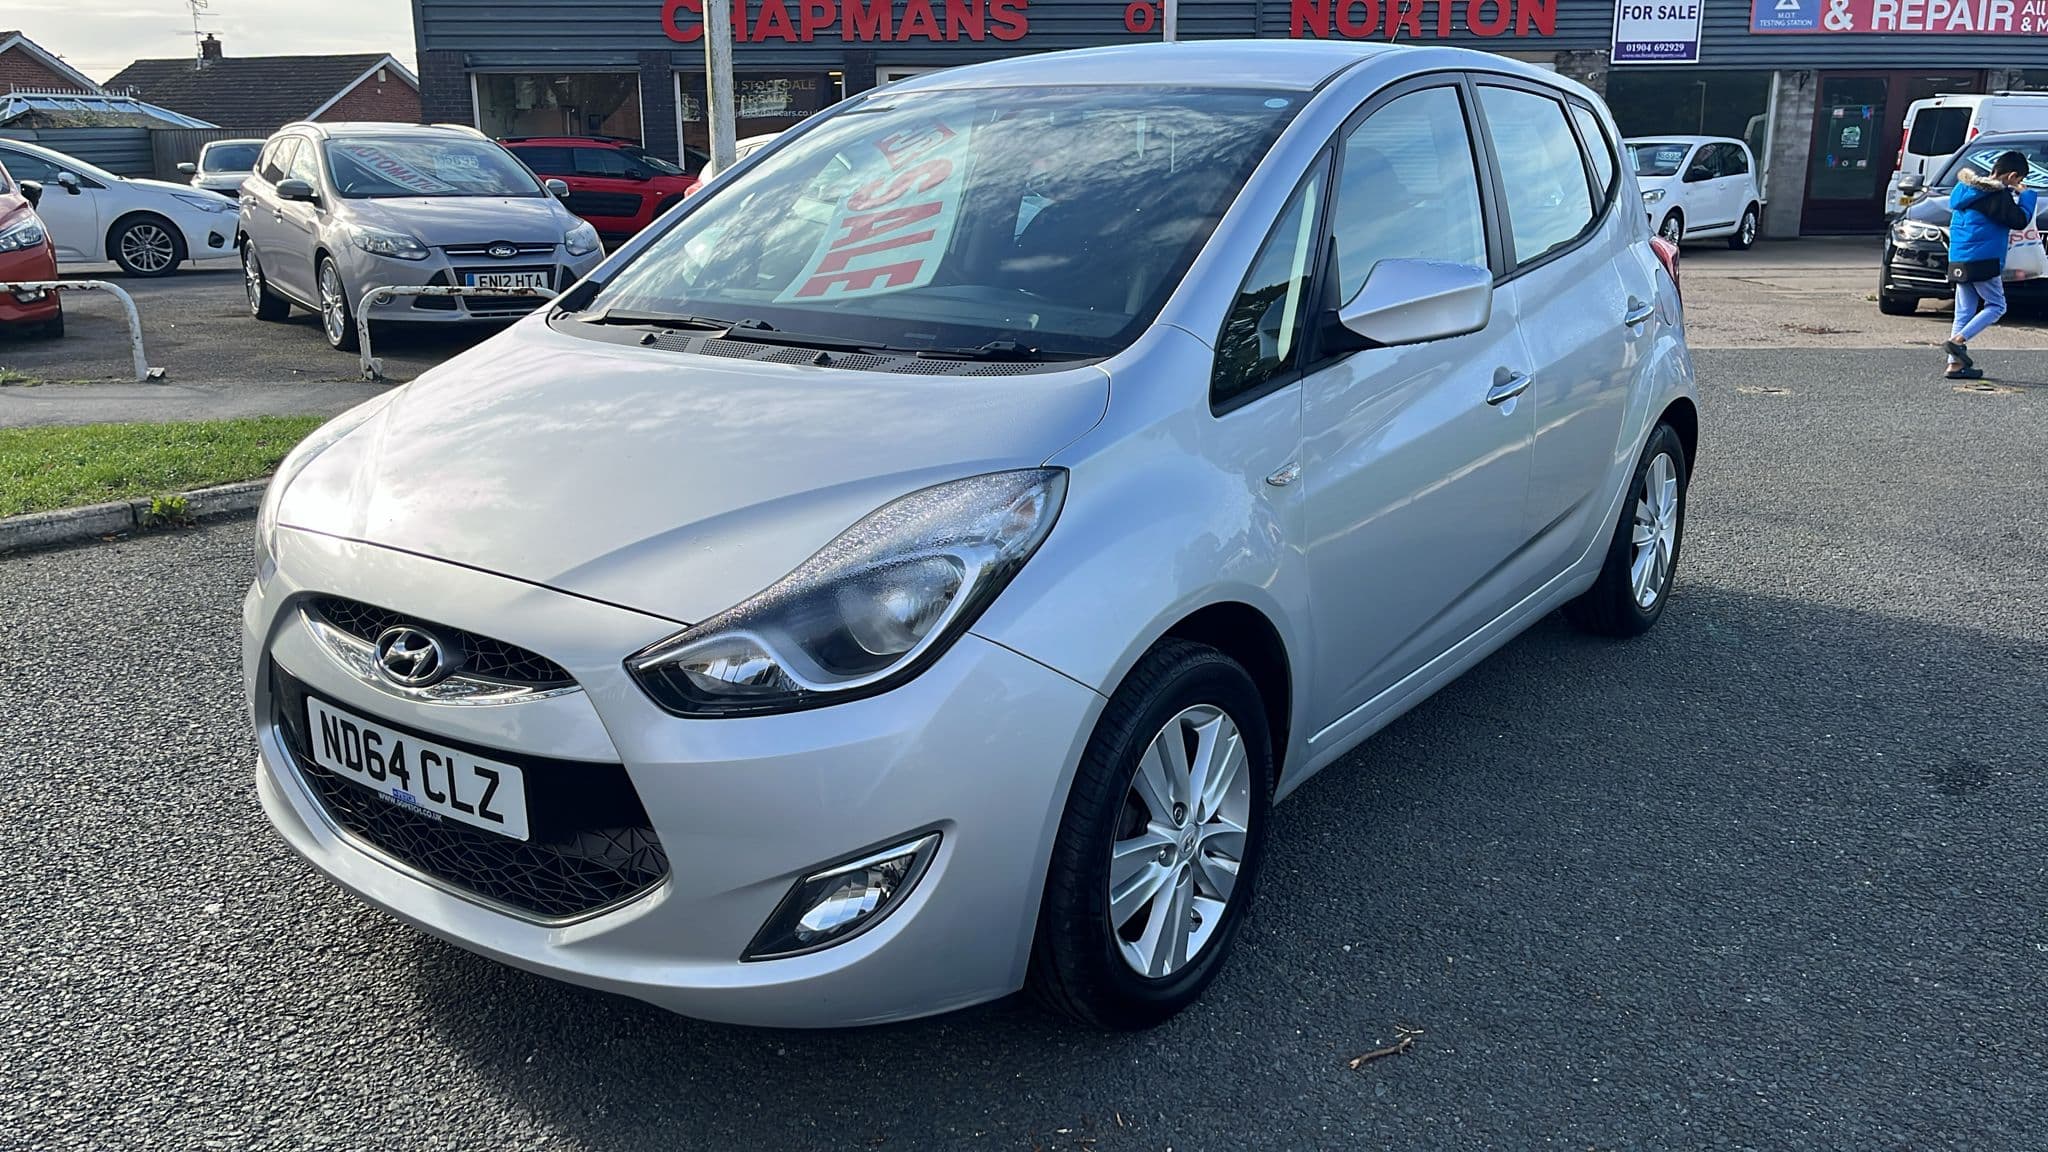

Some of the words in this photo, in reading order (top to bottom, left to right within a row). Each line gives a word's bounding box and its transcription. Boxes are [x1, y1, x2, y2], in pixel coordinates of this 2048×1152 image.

[1622, 5, 1653, 20] FOR
[1657, 5, 1697, 20] SALE
[1824, 0, 1854, 30] &
[1871, 0, 2016, 31] REPAIR
[2021, 0, 2046, 16] All
[1125, 0, 1164, 33] o
[1290, 0, 1557, 38] NORTON
[1760, 19, 1786, 27] TESTING
[1787, 18, 1813, 27] STATION
[2021, 17, 2033, 32] &
[1625, 43, 1652, 52] 01904
[1654, 43, 1685, 52] 692929
[741, 79, 816, 90] STOCKDALE
[349, 144, 441, 191] AUTOMATIC
[479, 275, 512, 288] EN12
[515, 274, 544, 288] HTA
[319, 709, 410, 791] ND64
[420, 749, 504, 824] CLZ
